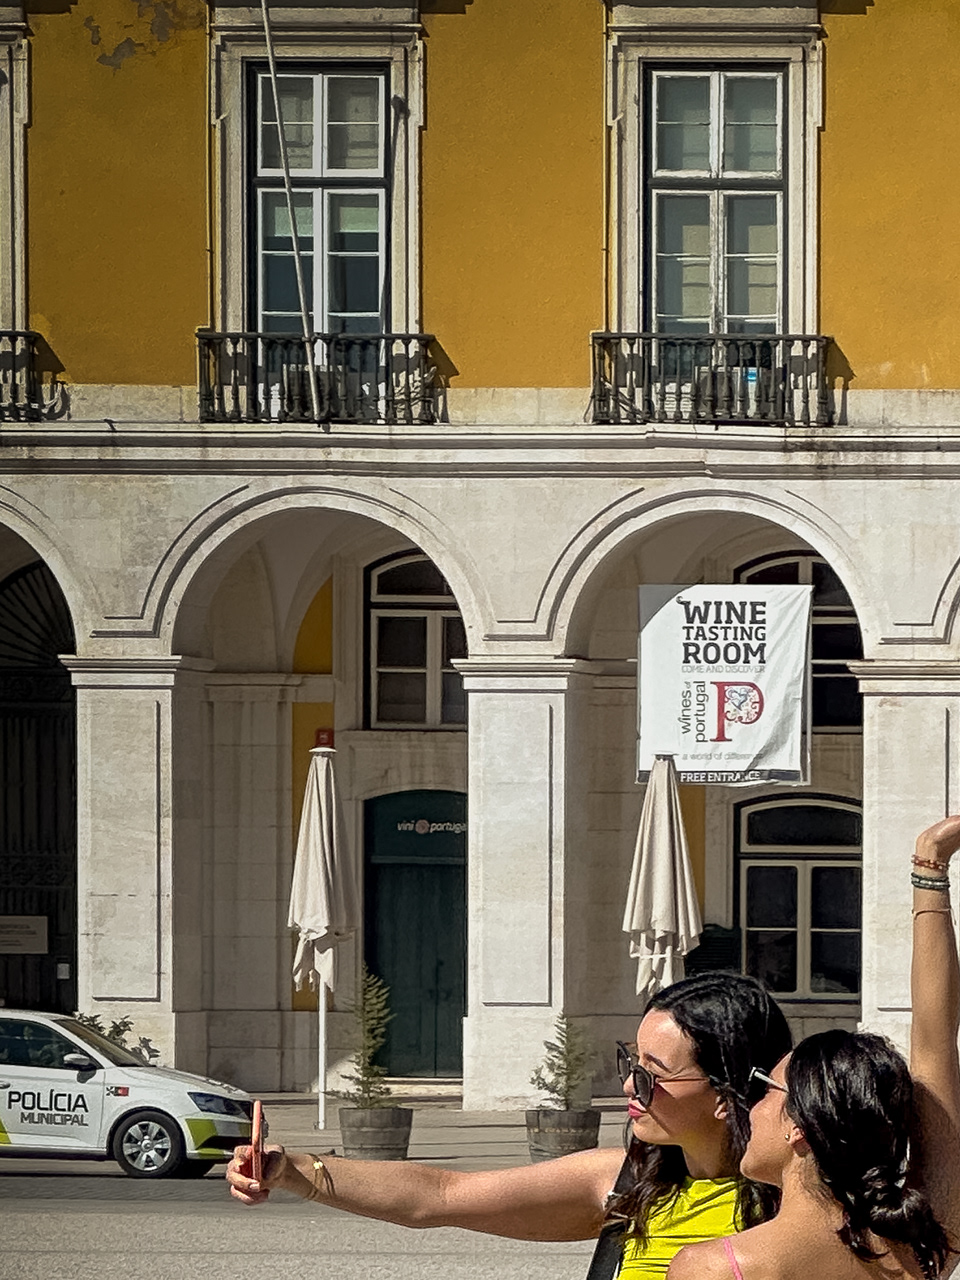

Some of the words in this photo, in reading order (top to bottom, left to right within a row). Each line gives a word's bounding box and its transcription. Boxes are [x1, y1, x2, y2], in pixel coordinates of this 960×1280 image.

[677, 598, 766, 624] WINE
[682, 626, 766, 641] TASTING
[682, 642, 766, 664] ROOM
[681, 665, 704, 673] COME
[706, 665, 724, 673] AND
[725, 665, 766, 673] DISCOVER
[678, 690, 692, 734] wines
[693, 681, 709, 742] portugal
[680, 772, 707, 782] FREE
[430, 821, 468, 833] portuga
[8, 1089, 89, 1113] POLÍCIA
[20, 1112, 89, 1126] MUNICIPAL
